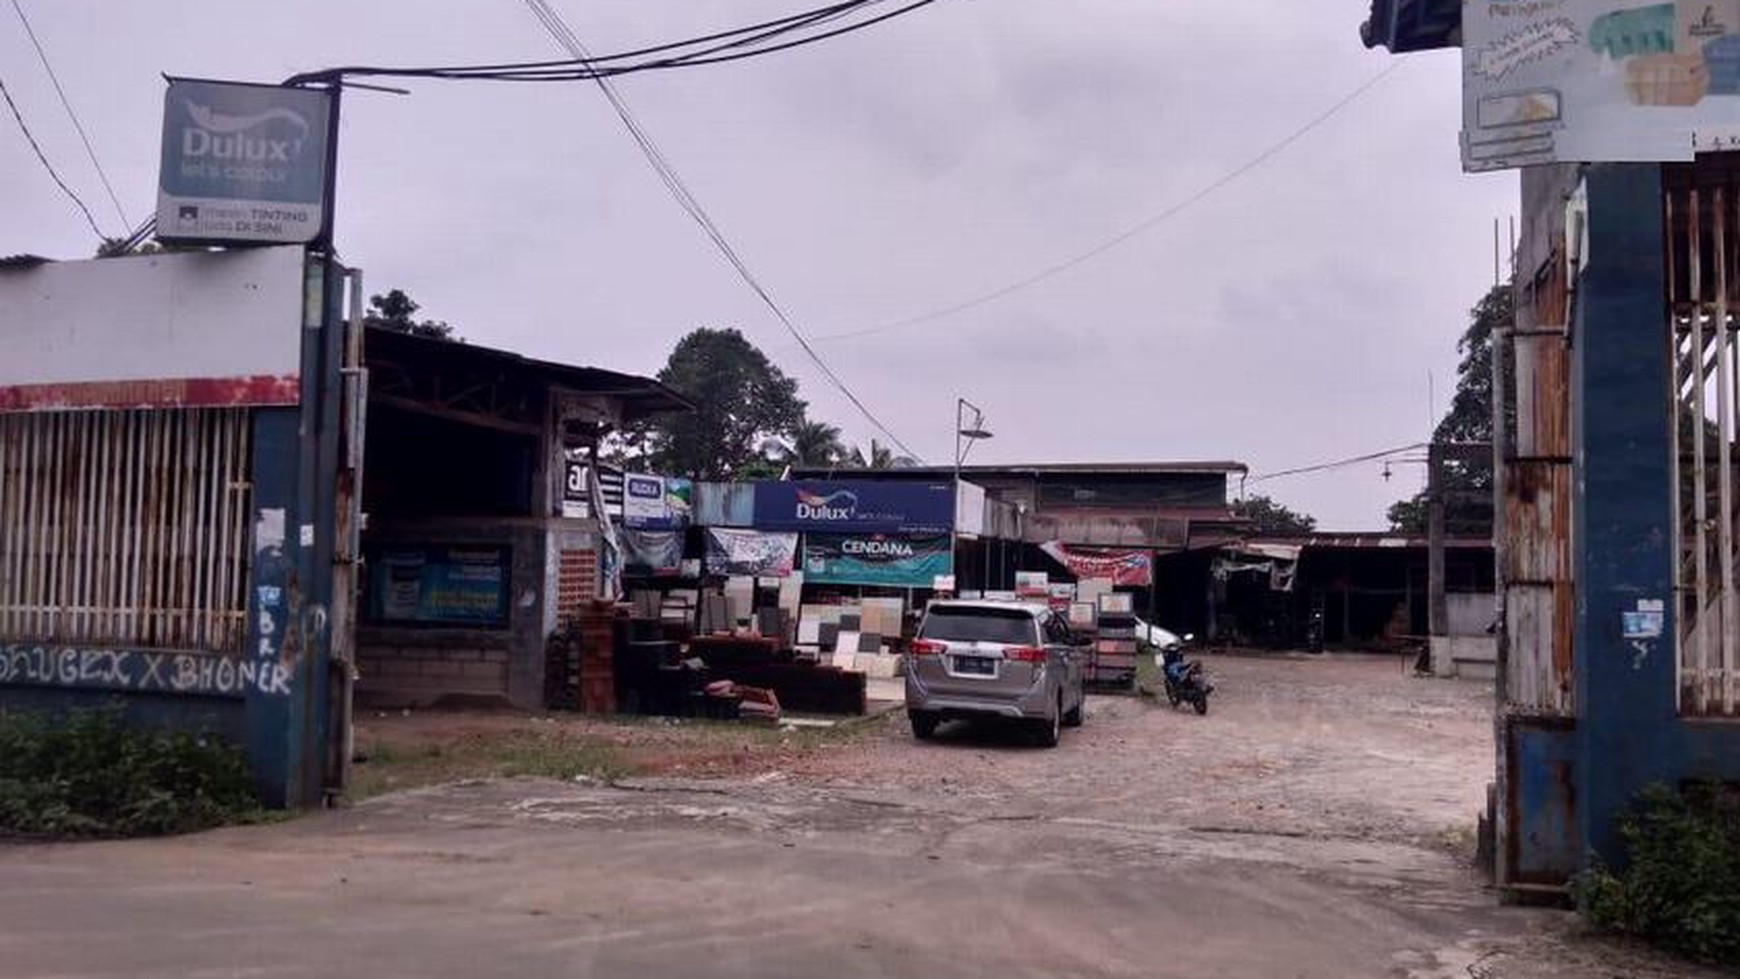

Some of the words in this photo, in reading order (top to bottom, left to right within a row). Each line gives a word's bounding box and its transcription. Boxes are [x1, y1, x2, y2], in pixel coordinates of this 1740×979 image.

[182, 128, 288, 161] Dulux
[796, 503, 850, 521] Dulux
[841, 539, 914, 556] CENDANA
